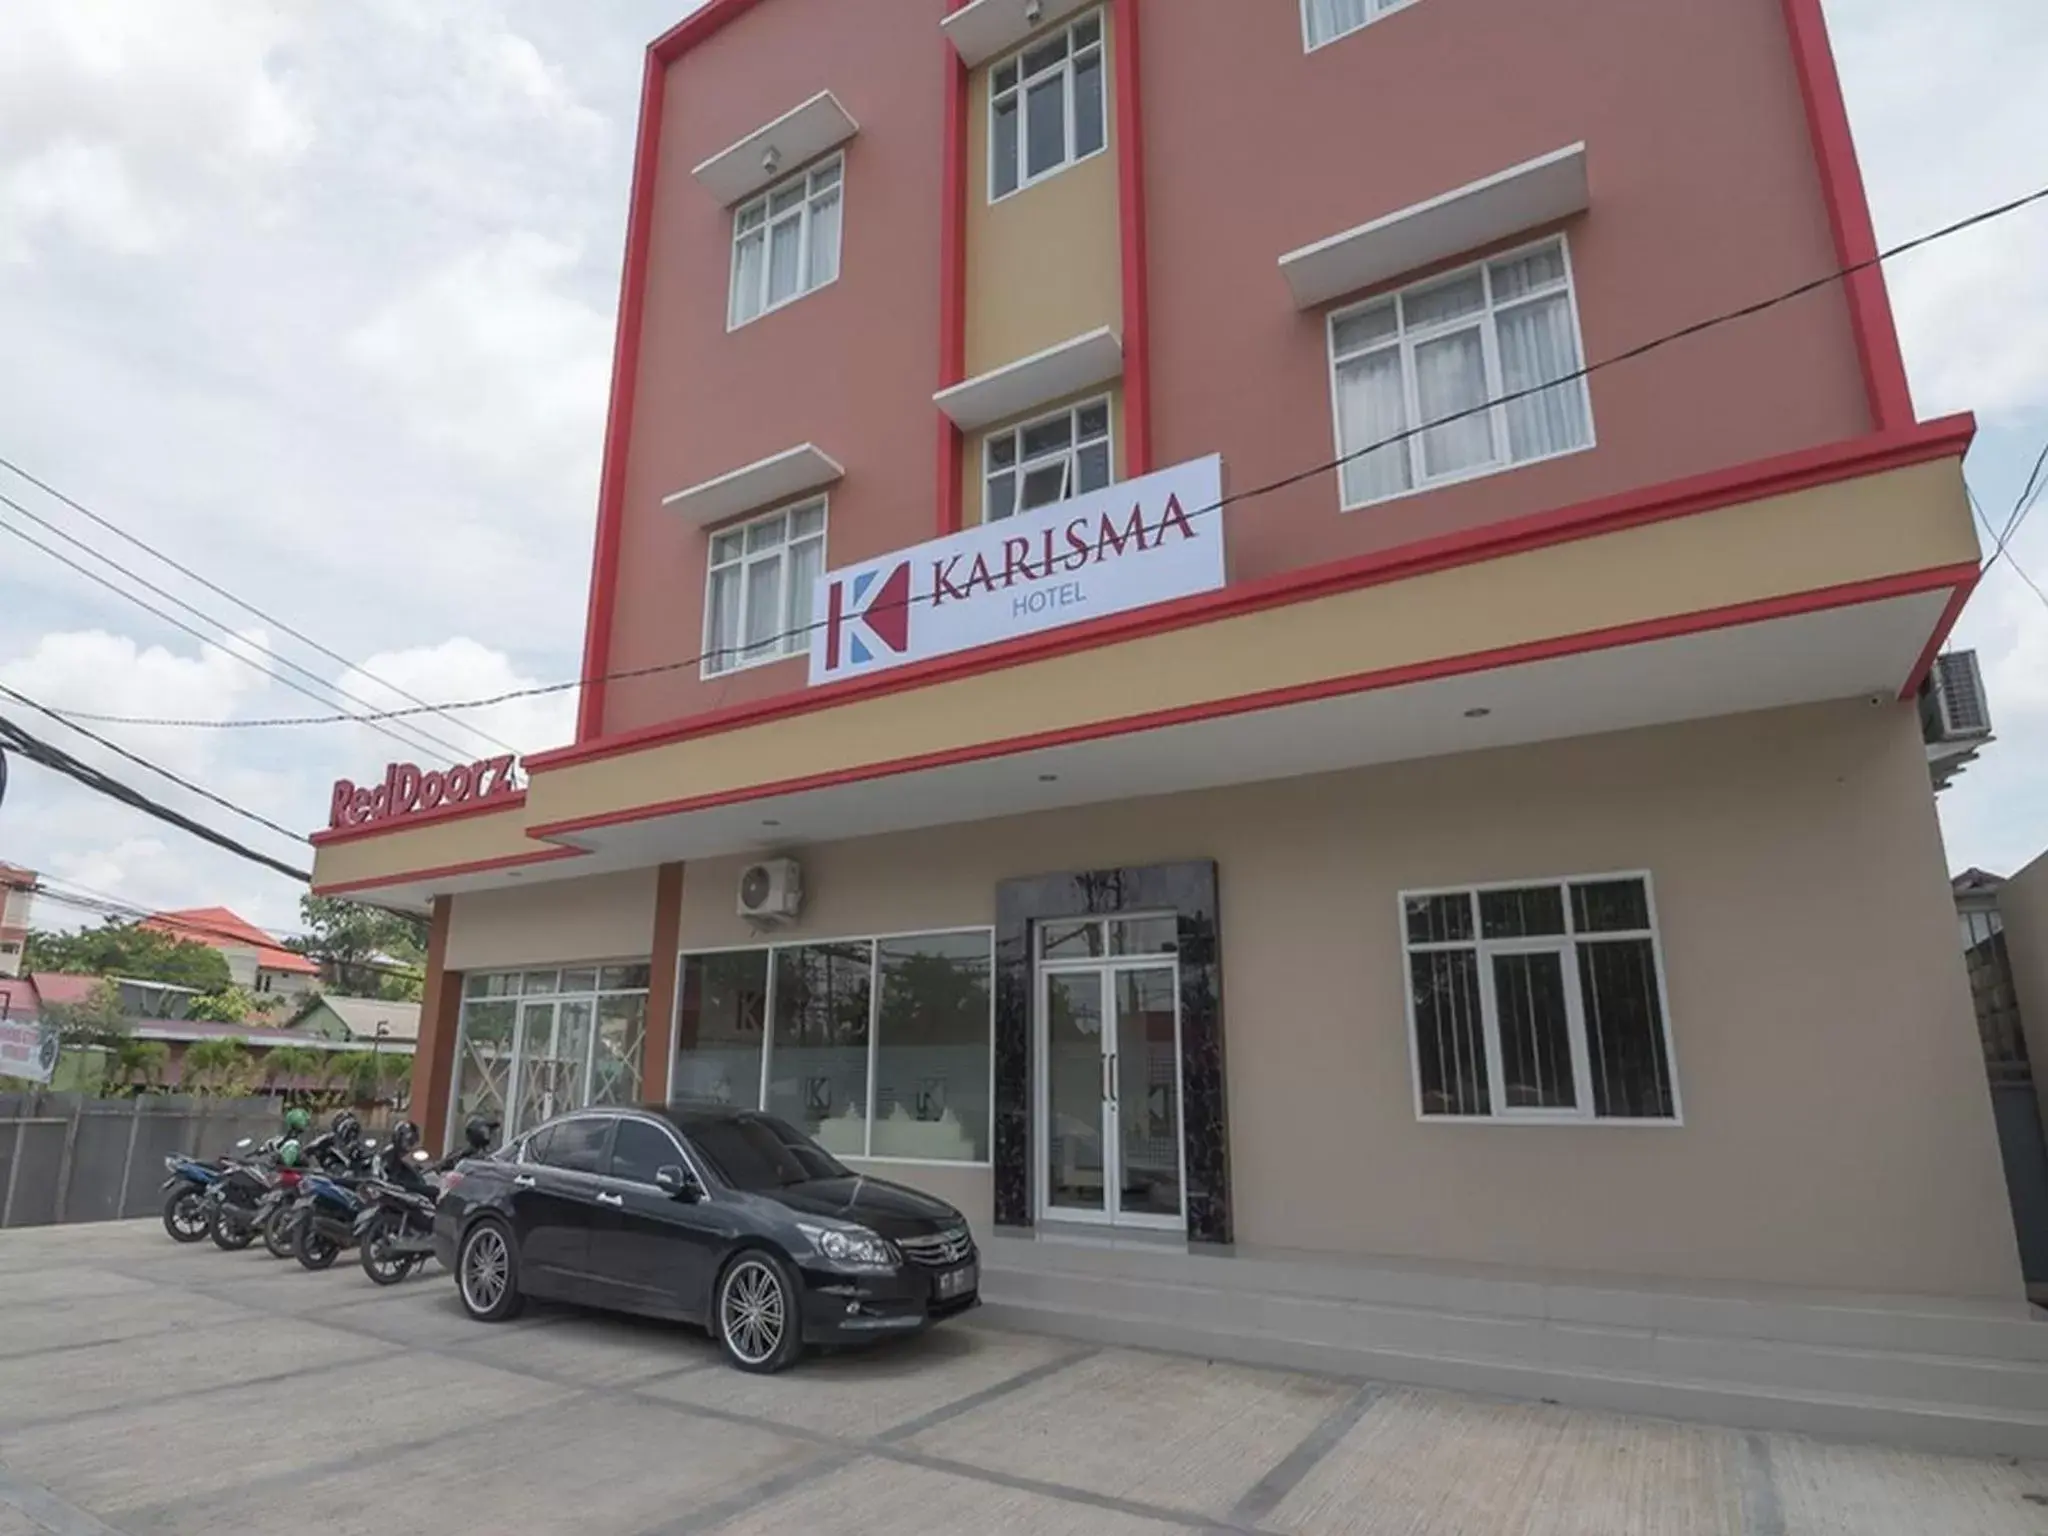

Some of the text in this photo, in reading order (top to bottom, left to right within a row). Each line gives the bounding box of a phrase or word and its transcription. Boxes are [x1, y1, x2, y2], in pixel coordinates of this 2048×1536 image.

[930, 491, 1199, 607] KARISMA
[825, 559, 912, 672] K
[1012, 578, 1088, 619] HOTEL
[330, 754, 516, 828] RedDoorz
